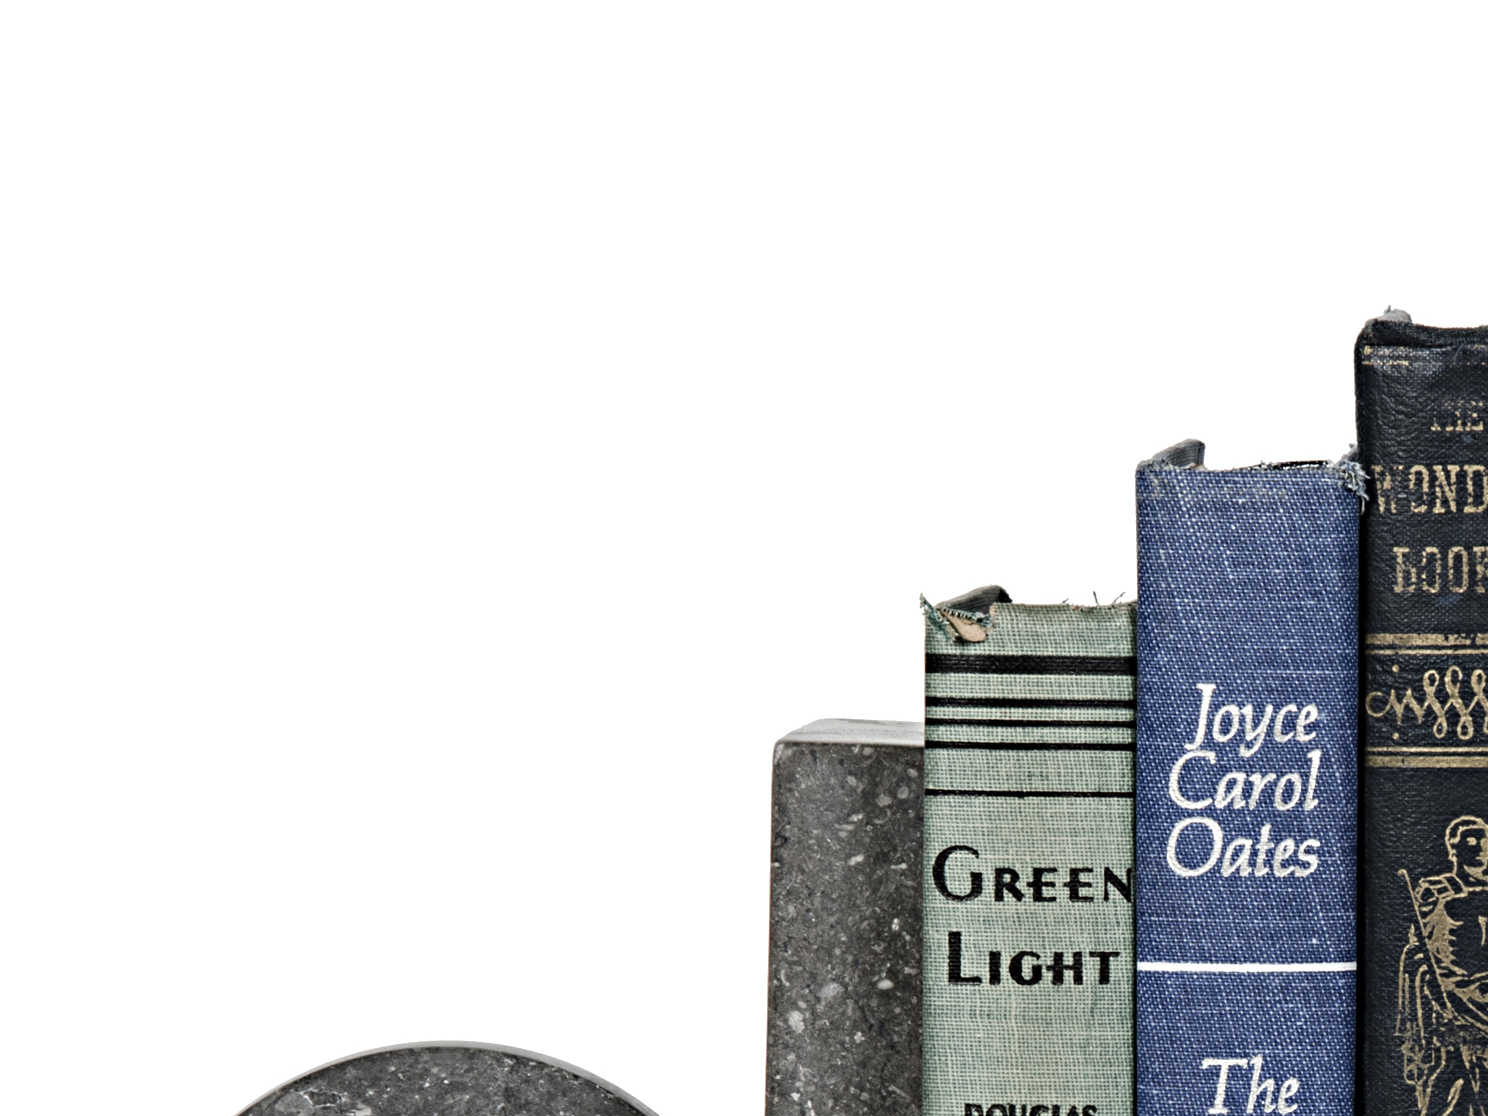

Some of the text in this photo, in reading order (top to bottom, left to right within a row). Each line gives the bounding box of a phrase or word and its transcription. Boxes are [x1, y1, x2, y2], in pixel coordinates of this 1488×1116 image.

[1185, 683, 1318, 758] Joyce
[1167, 750, 1320, 812] Carol
[932, 845, 1133, 902] GREEN
[1166, 815, 1321, 878] Oates
[947, 931, 1120, 986] LIGHT
[1202, 1054, 1299, 1116] The
